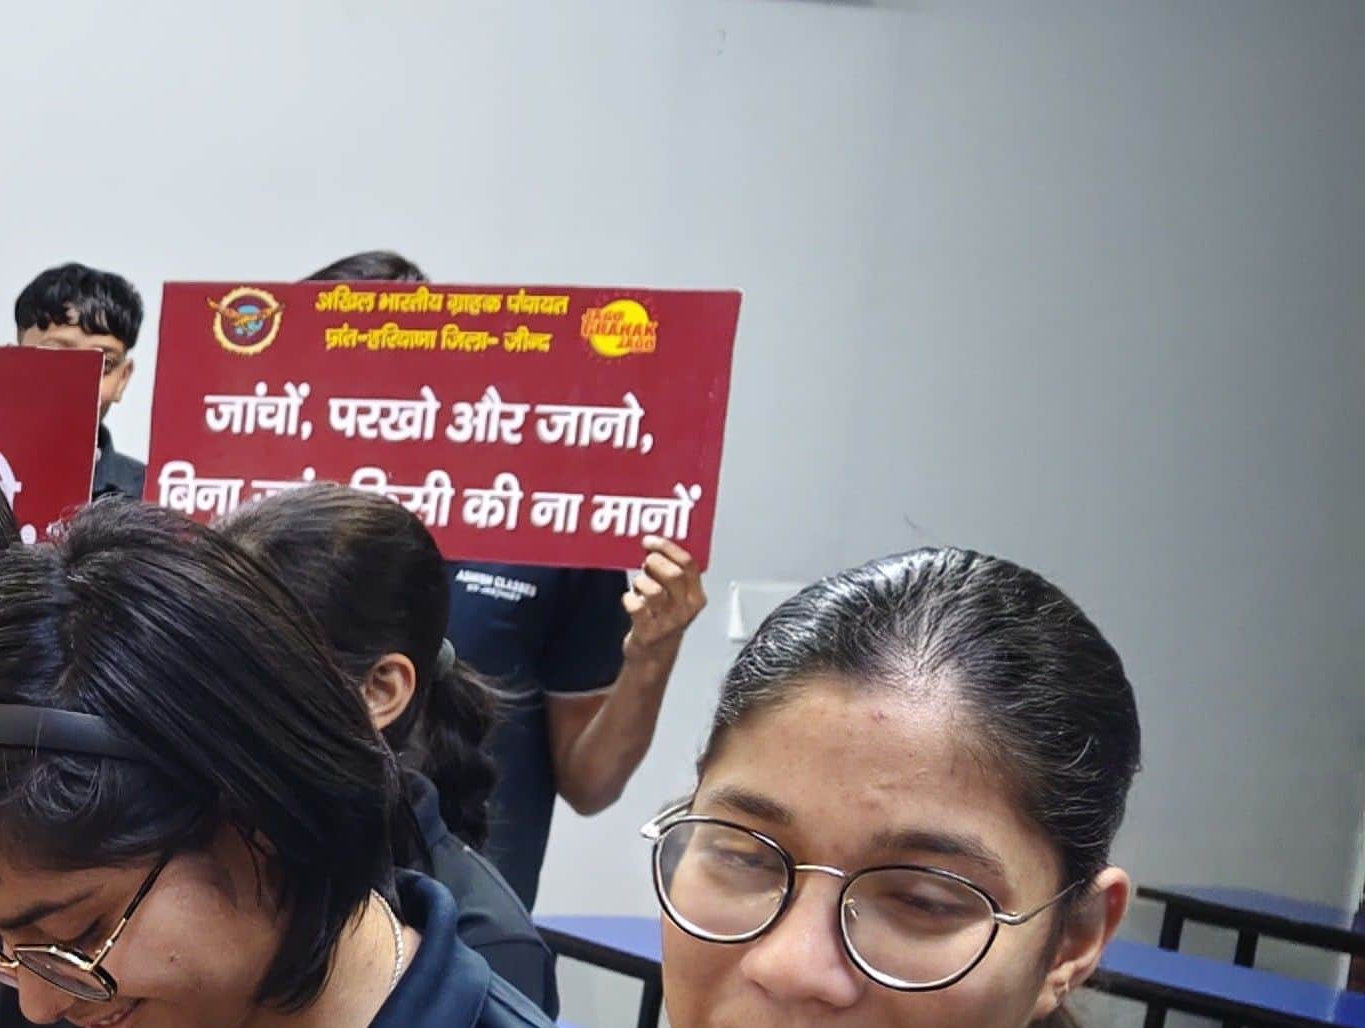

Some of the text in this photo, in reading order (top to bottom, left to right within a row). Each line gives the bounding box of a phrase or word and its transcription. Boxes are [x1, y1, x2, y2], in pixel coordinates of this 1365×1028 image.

[203, 381, 654, 454] जांचों, परखो और जानो,
[158, 460, 243, 516] बिना
[462, 472, 524, 530] की
[530, 491, 585, 533] ना
[590, 483, 702, 540] मानों
